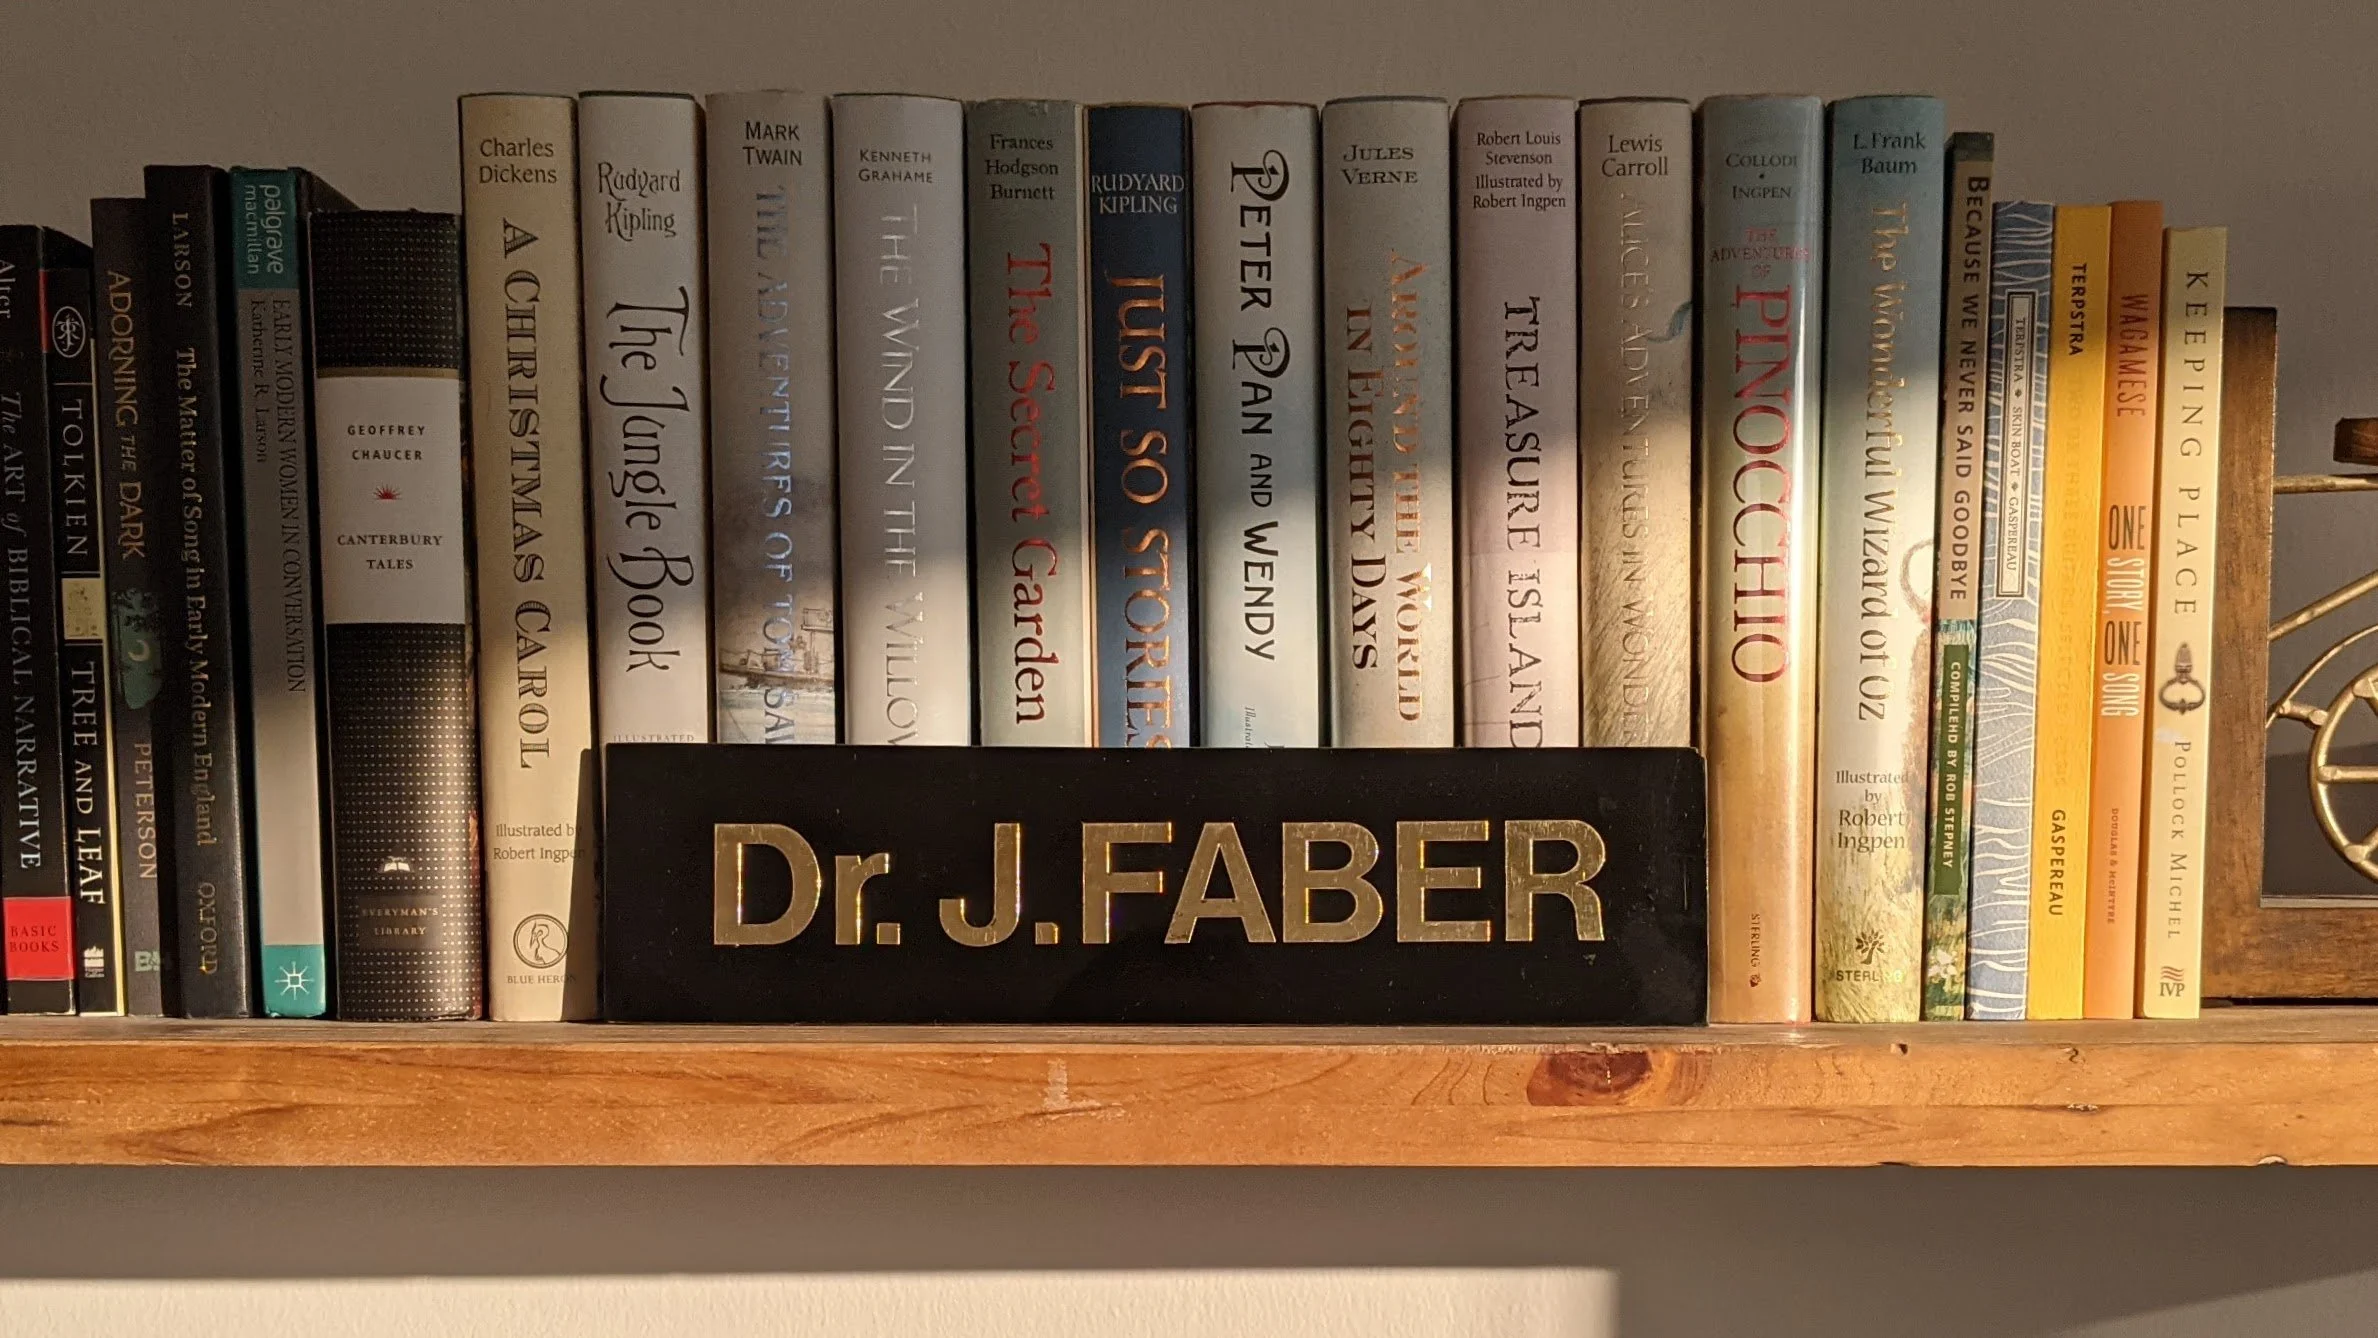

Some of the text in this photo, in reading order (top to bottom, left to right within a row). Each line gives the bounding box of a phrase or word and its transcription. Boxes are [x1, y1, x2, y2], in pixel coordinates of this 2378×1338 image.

[480, 137, 554, 158] Charles
[745, 121, 800, 142] MARK
[990, 134, 1054, 150] Frances
[1476, 132, 1562, 146] Robert Louis
[1608, 134, 1663, 154] Lewis
[1853, 130, 1926, 151] L. Frank
[743, 146, 803, 166] TWAIN
[859, 149, 932, 164] KENNETH
[984, 159, 1059, 177] Hodgson
[1343, 144, 1415, 162] JULES
[1485, 151, 1553, 165] Stevenson
[1601, 157, 1669, 177] Carroll
[1726, 153, 1798, 169] COLLODI
[1861, 157, 1917, 175] Baum
[478, 165, 558, 185] Dickens
[598, 161, 681, 200] Rudyard
[858, 168, 933, 184] GRAHAME
[991, 183, 1055, 200] Burnett
[1091, 174, 1186, 194] RUDYARD
[1340, 168, 1419, 185] VERNE
[1475, 174, 1563, 193] Illustrated by
[1732, 185, 1792, 200] INGPEN
[604, 201, 677, 242] Kipling
[755, 185, 788, 260] THE
[1099, 196, 1178, 215] KIPLING
[1473, 194, 1567, 211] Robert Ingpen
[246, 184, 259, 276] macmillan
[259, 184, 285, 276] palgrave
[172, 212, 193, 308] LARSON
[1710, 247, 1810, 264] ADVENTURES
[2068, 262, 2088, 357] TERPSTRA
[1104, 269, 1168, 410] JUST
[2117, 293, 2149, 418] WAGAMESE
[250, 300, 273, 464] Katherine Larson
[756, 271, 793, 519] ADVENTURES
[880, 203, 920, 577] THE WIND IN THE
[1619, 192, 1653, 583] ALICE'S ADVENTURES IN
[1949, 175, 1989, 600] BECAUSE WE NEVER SAID GOODBYE
[106, 270, 146, 560] ADORNING THE DARK
[1231, 149, 1291, 661] PETER PAN AND WENDY
[347, 425, 426, 437] GEOFFREY
[2006, 317, 2027, 572] TERPSTRA SKIN BOAT GASPEREAU
[2174, 270, 2210, 615] KEEPING PLACE
[351, 449, 423, 461] CHAUCER
[1120, 429, 1168, 504] SO
[1857, 202, 1909, 721] The Wonderful Wizard of Oz
[61, 398, 88, 557] TOLKIEN
[272, 300, 306, 692] EARLY MODERN WOMEN IN CONVERSATION
[503, 217, 552, 769] A CHRISTMAS CAROL
[599, 285, 694, 673] The Jungle Book
[1007, 242, 1060, 725] The Secret Garden
[1346, 302, 1387, 670] IN EIGHTY DAYS
[1389, 249, 1432, 722] AROUND THE WORLD
[1731, 284, 1793, 683] PINOCCHIO
[337, 535, 444, 547] CANTERBURY
[1504, 295, 1544, 747] TREASURE ISLAND
[366, 558, 414, 570] TALES
[764, 532, 793, 582] OF
[175, 348, 217, 847] The Matter of Song in Early Modern England
[2100, 504, 2147, 718] ONE STORY, ONE SONG
[1, 392, 41, 869] The ART of BIBLICAL NARRATIVE
[71, 660, 106, 905] TREE AND LEAF
[1835, 770, 1909, 784] Illustrated
[1941, 660, 1961, 869] COMPILEHD BY ROB STEPNEY
[133, 743, 158, 879] PETERSON
[1864, 786, 1882, 804] by
[496, 824, 558, 837] Illustrated
[1838, 809, 1905, 827] Robert
[493, 848, 585, 864] Robert Ingpen
[1837, 832, 1906, 853] Ingpen
[2167, 741, 2193, 939] POLLOCK MICHEL
[2048, 808, 2067, 917] GASPEREAU
[2106, 807, 2119, 925] DOUGLAS McINTYRE
[713, 821, 902, 946] Dr.
[198, 882, 219, 975] OXFORD
[361, 905, 440, 918] EVERYMAN'S
[374, 925, 427, 937] LIBRARY
[9, 940, 60, 953] BOOKS
[10, 926, 57, 938] BASIC
[1751, 913, 1762, 968] STERLING
[507, 975, 575, 984] BLUE HERON
[2160, 982, 2186, 998] IVP
